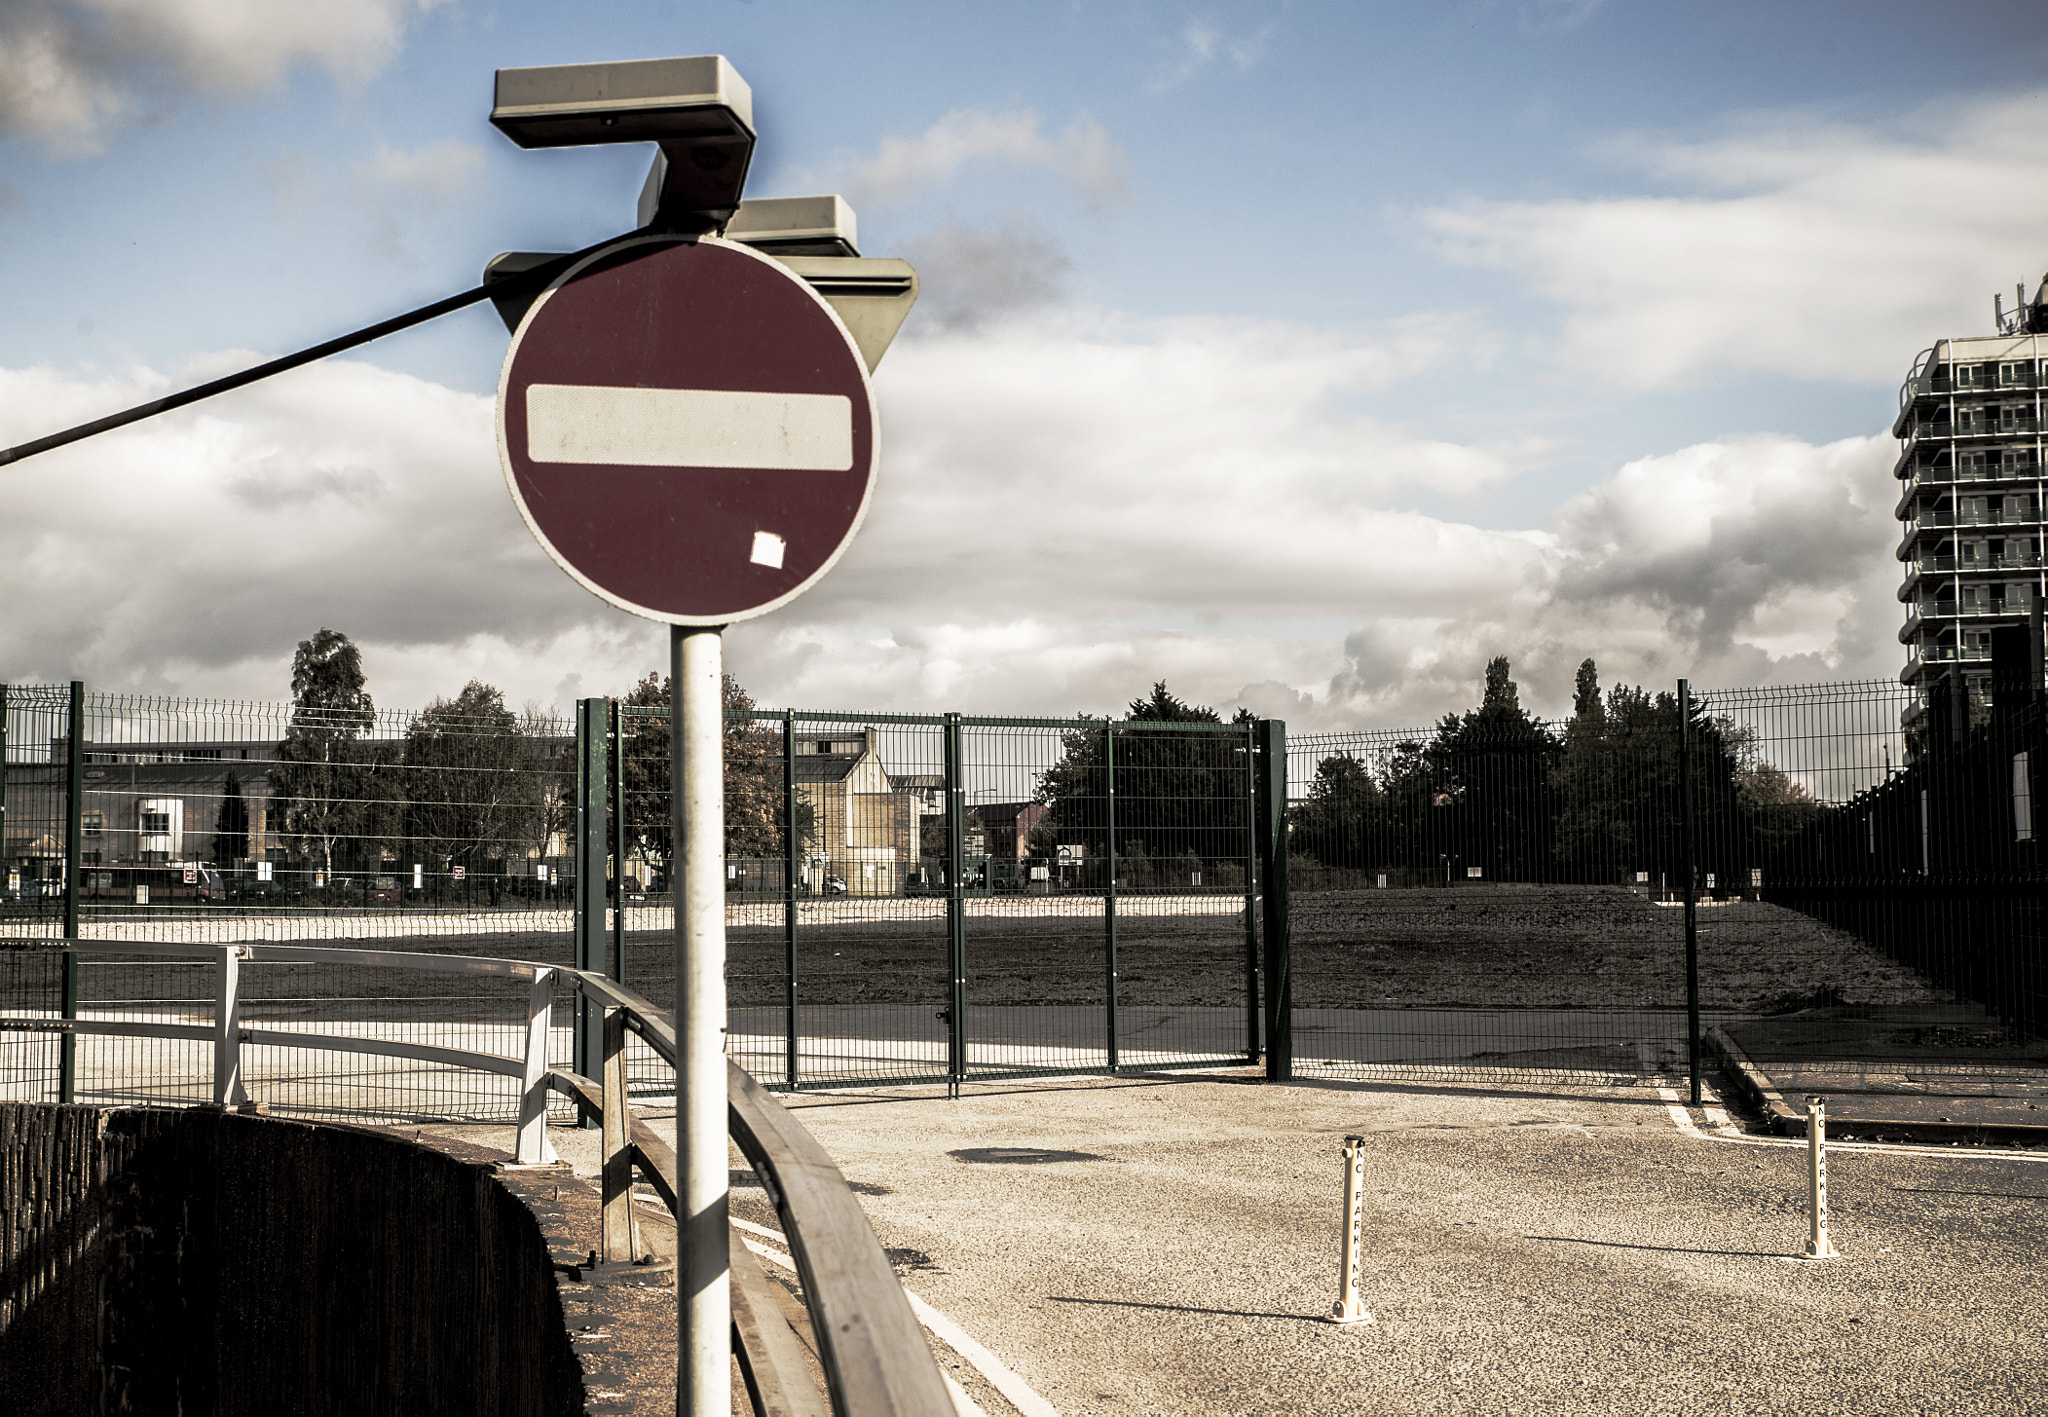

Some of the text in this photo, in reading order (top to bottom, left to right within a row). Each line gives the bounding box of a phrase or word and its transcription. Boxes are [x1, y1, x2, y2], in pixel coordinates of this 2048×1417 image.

[1351, 1149, 1363, 1288] NO PARKING
[1818, 1107, 1827, 1229] NO PARKING
